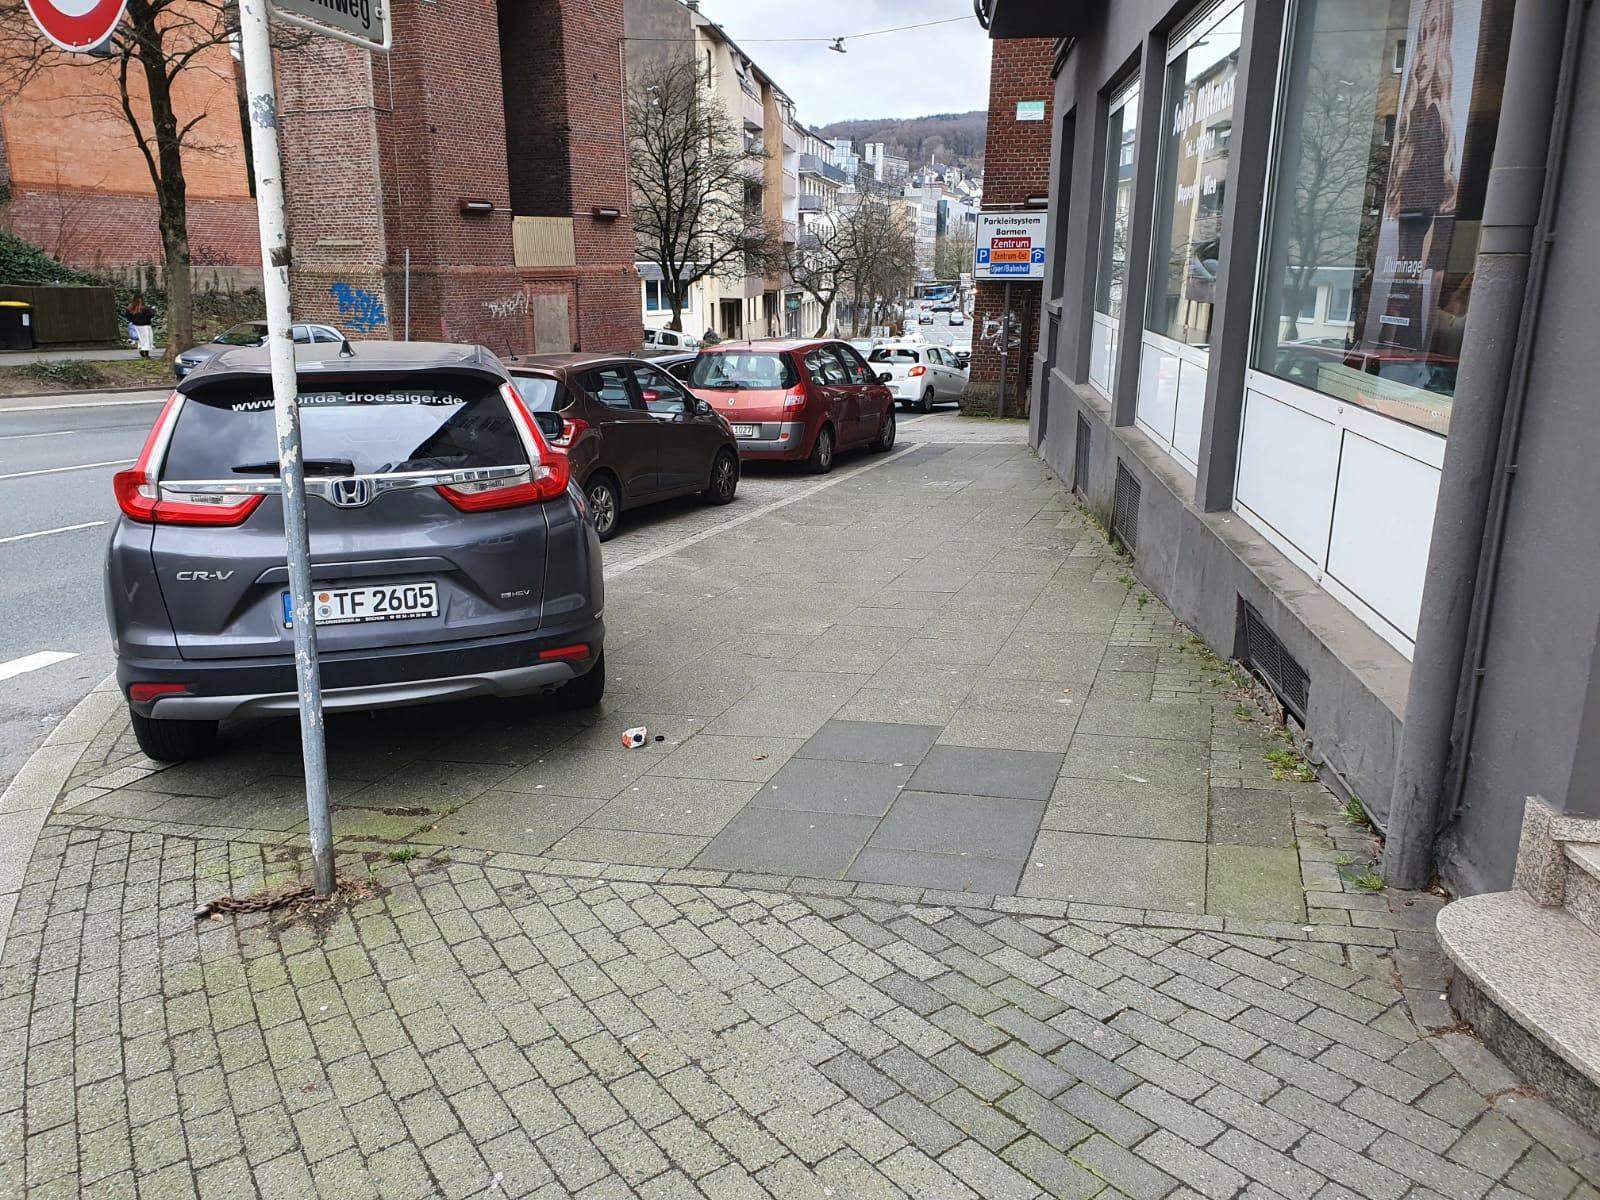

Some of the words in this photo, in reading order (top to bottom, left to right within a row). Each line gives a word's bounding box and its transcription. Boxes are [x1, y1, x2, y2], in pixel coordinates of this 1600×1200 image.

[984, 217, 1040, 225] Parkleitsystem
[996, 228, 1027, 236] Barmen
[993, 239, 1029, 248] Zentrum
[176, 570, 235, 581] CR-V
[333, 591, 365, 615] TF
[372, 586, 433, 613] 2605
